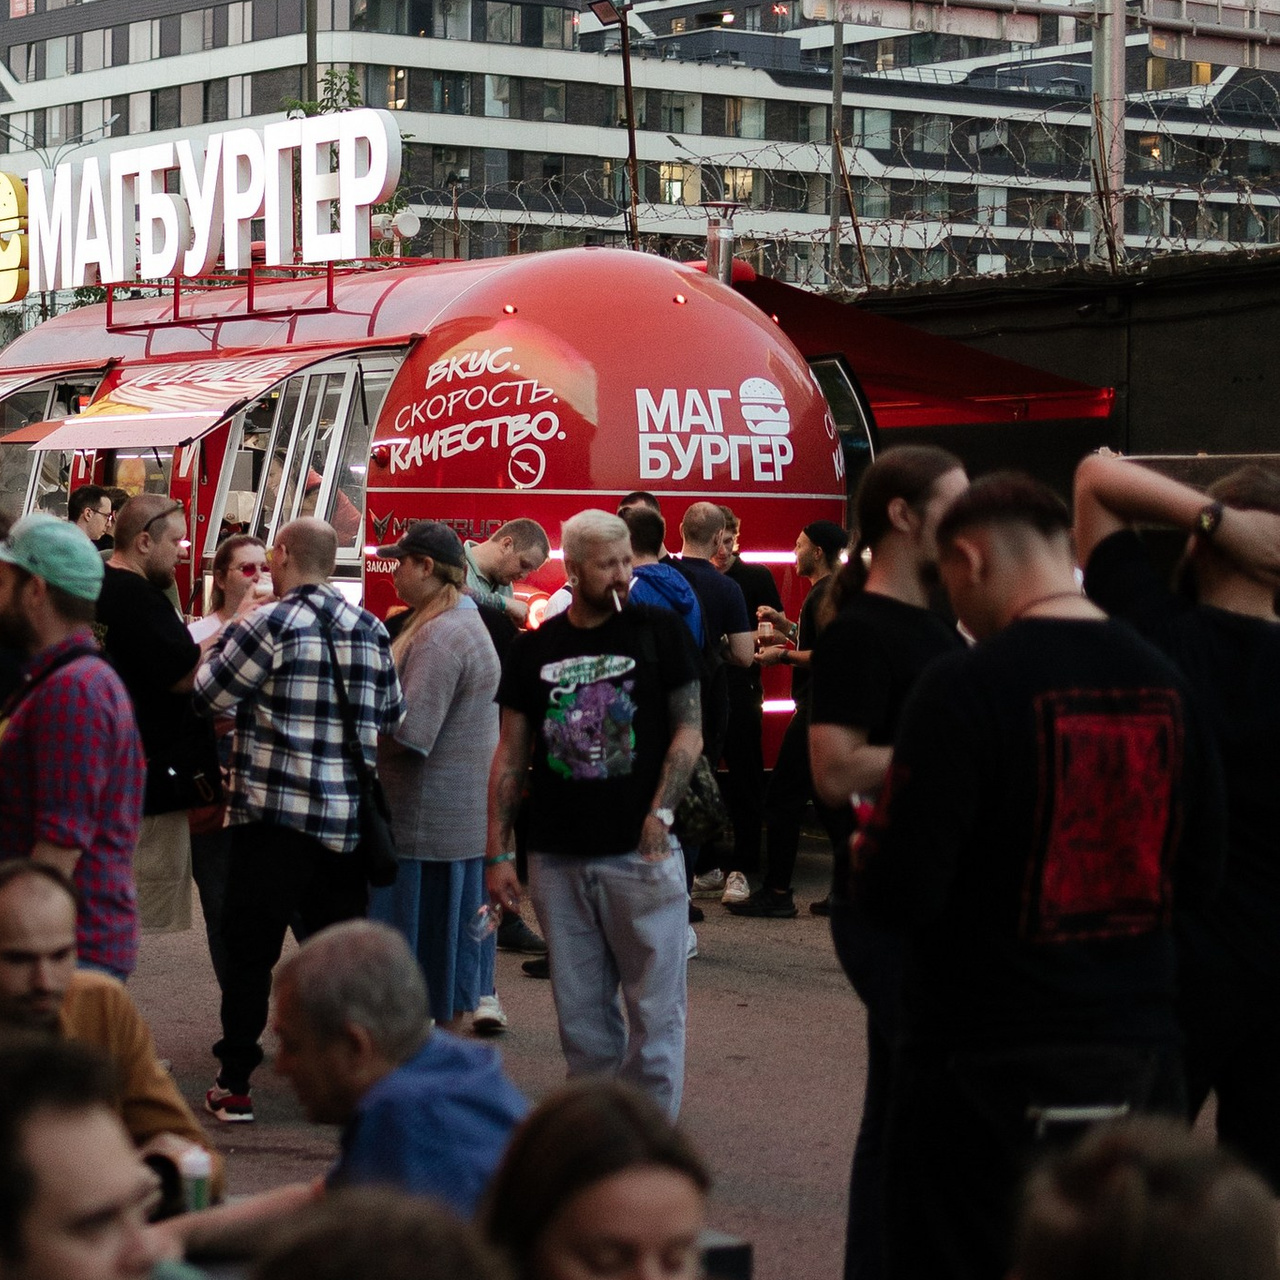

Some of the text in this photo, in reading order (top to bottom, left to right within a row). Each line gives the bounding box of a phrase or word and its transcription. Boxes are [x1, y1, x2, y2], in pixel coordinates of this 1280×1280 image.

[27, 108, 401, 292] МАГБУРГЕР
[425, 346, 521, 390] ВКУС.
[395, 378, 559, 433] СКОРОСТЬ.
[636, 388, 732, 433] МАГ
[389, 411, 567, 474] КАЧЕСТВО.
[639, 433, 794, 482] БУРГЕР
